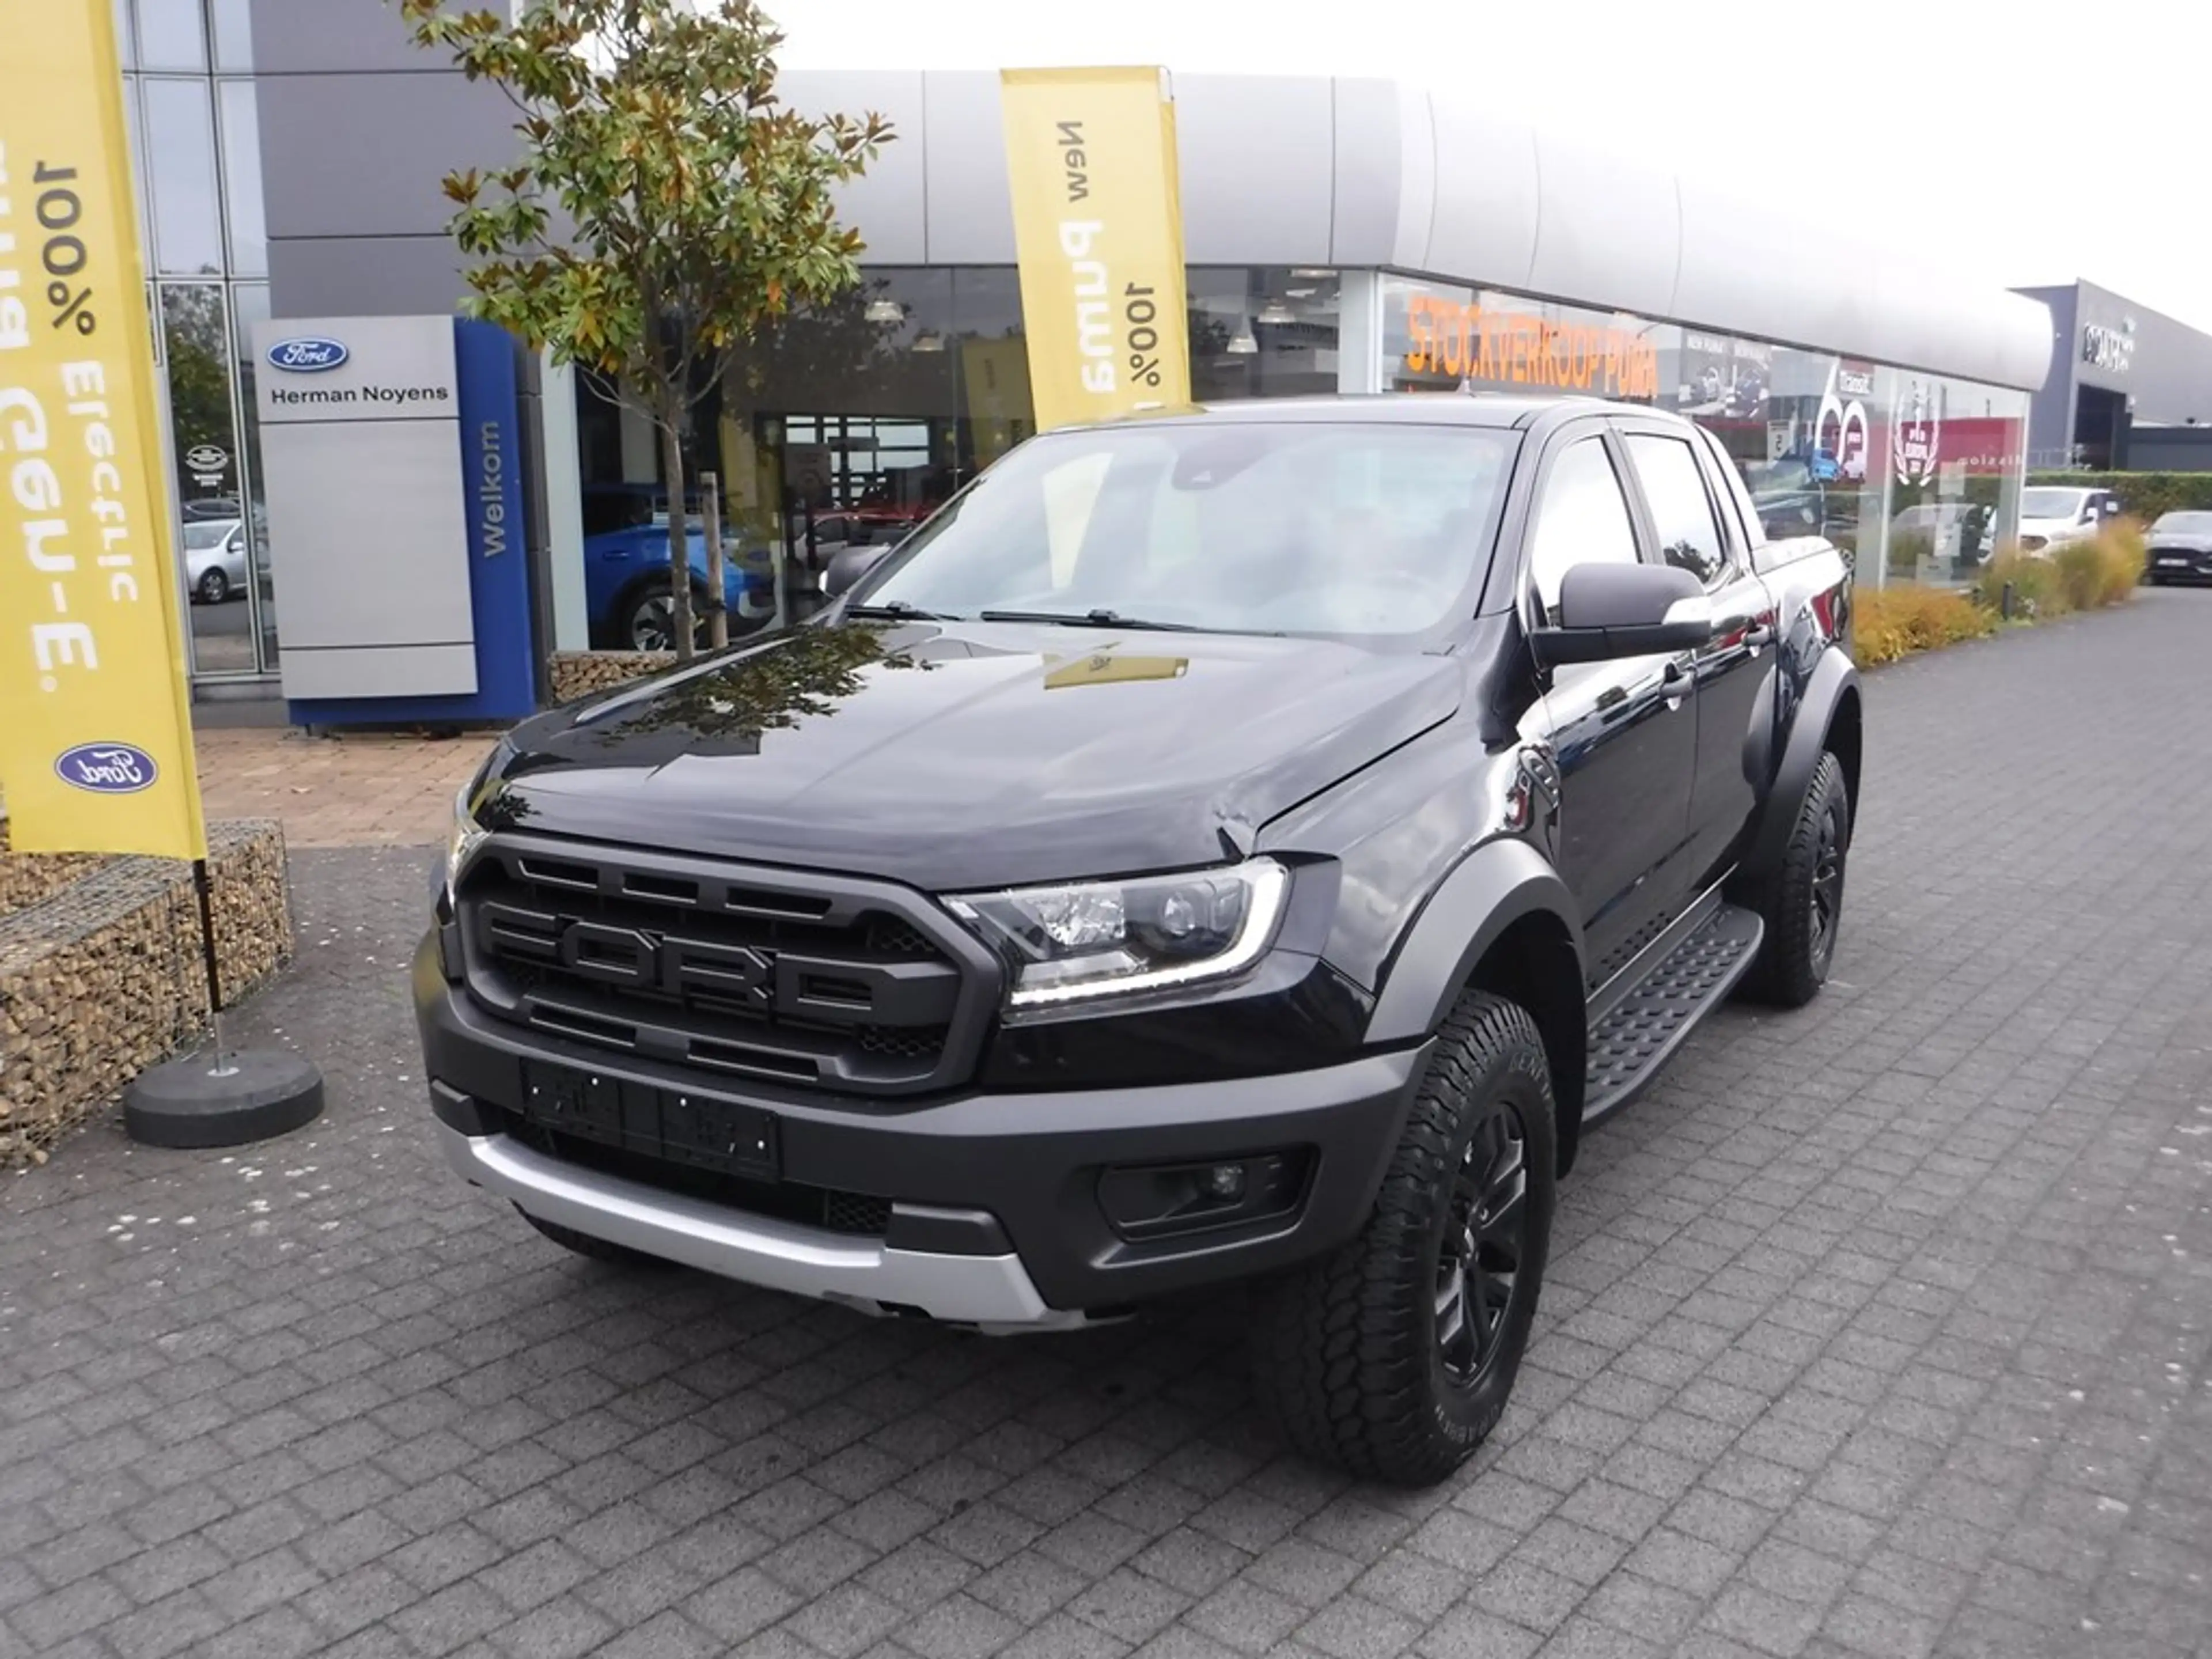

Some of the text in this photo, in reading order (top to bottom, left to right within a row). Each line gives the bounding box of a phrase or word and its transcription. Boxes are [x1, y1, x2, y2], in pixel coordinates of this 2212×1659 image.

[283, 343, 331, 364] Ford
[271, 385, 448, 404] Herman Noyens
[480, 421, 506, 558] Welkom
[478, 900, 922, 1027] FORD
